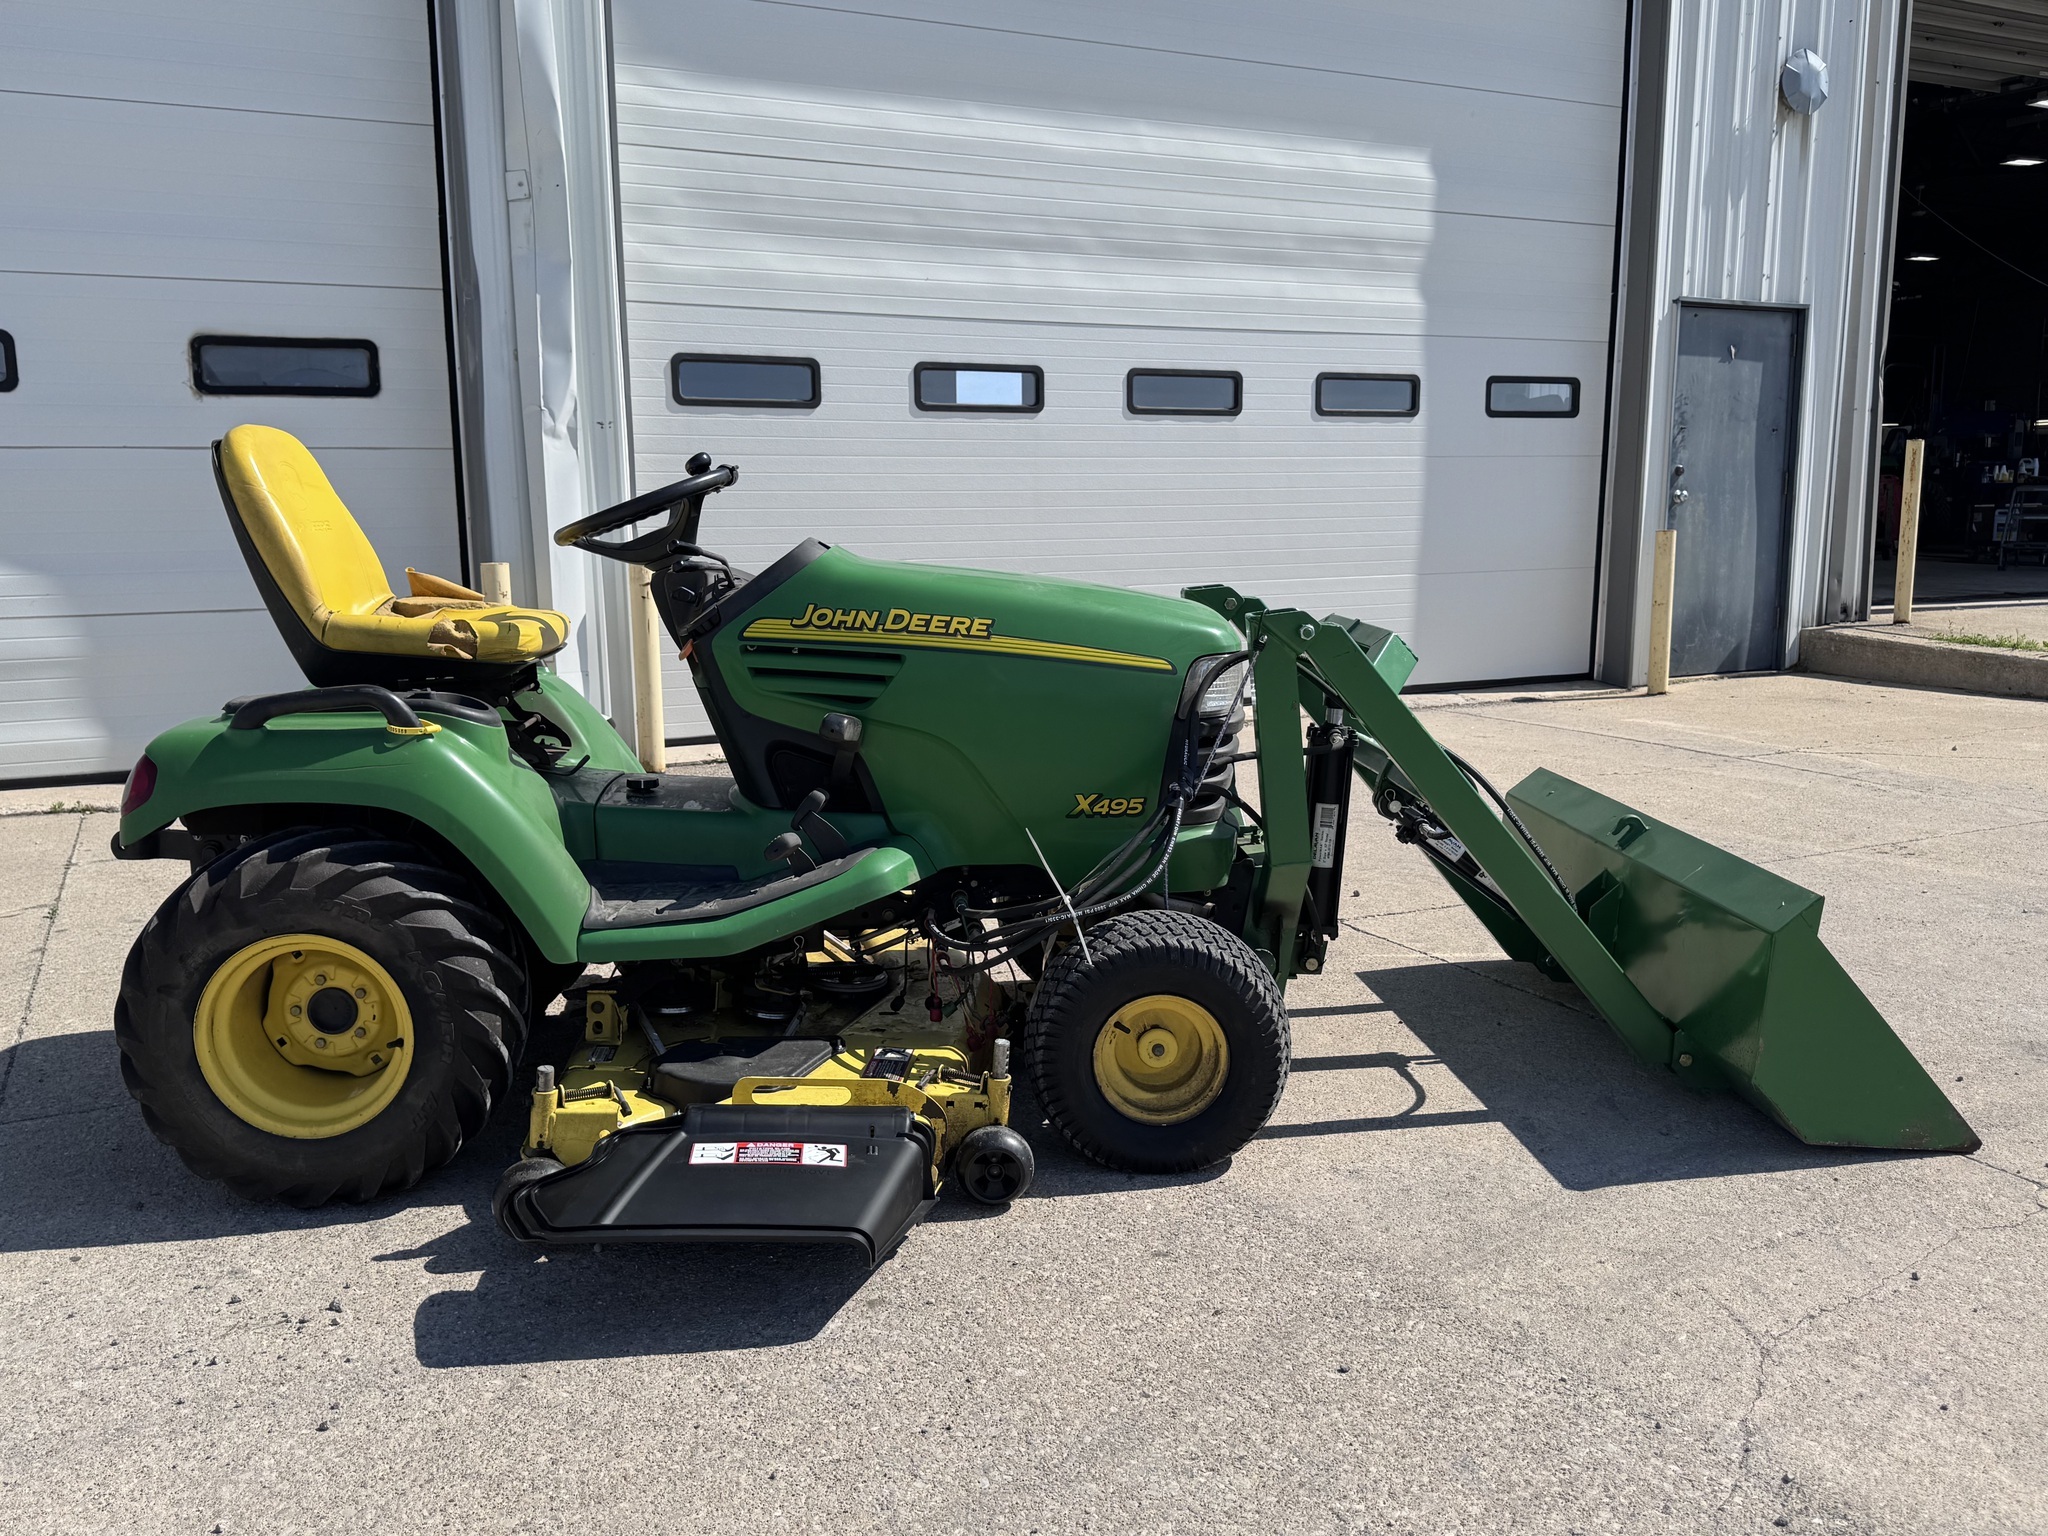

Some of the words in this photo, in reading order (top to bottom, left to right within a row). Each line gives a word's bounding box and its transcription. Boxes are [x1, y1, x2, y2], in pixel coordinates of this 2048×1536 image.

[792, 603, 882, 630] JOHN
[883, 608, 995, 639] DEERE
[1067, 793, 1147, 818] X495
[1151, 863, 1164, 879] MADE
[1145, 876, 1153, 884] IN
[1130, 882, 1147, 896] CHINA
[1118, 893, 1132, 903] MAX
